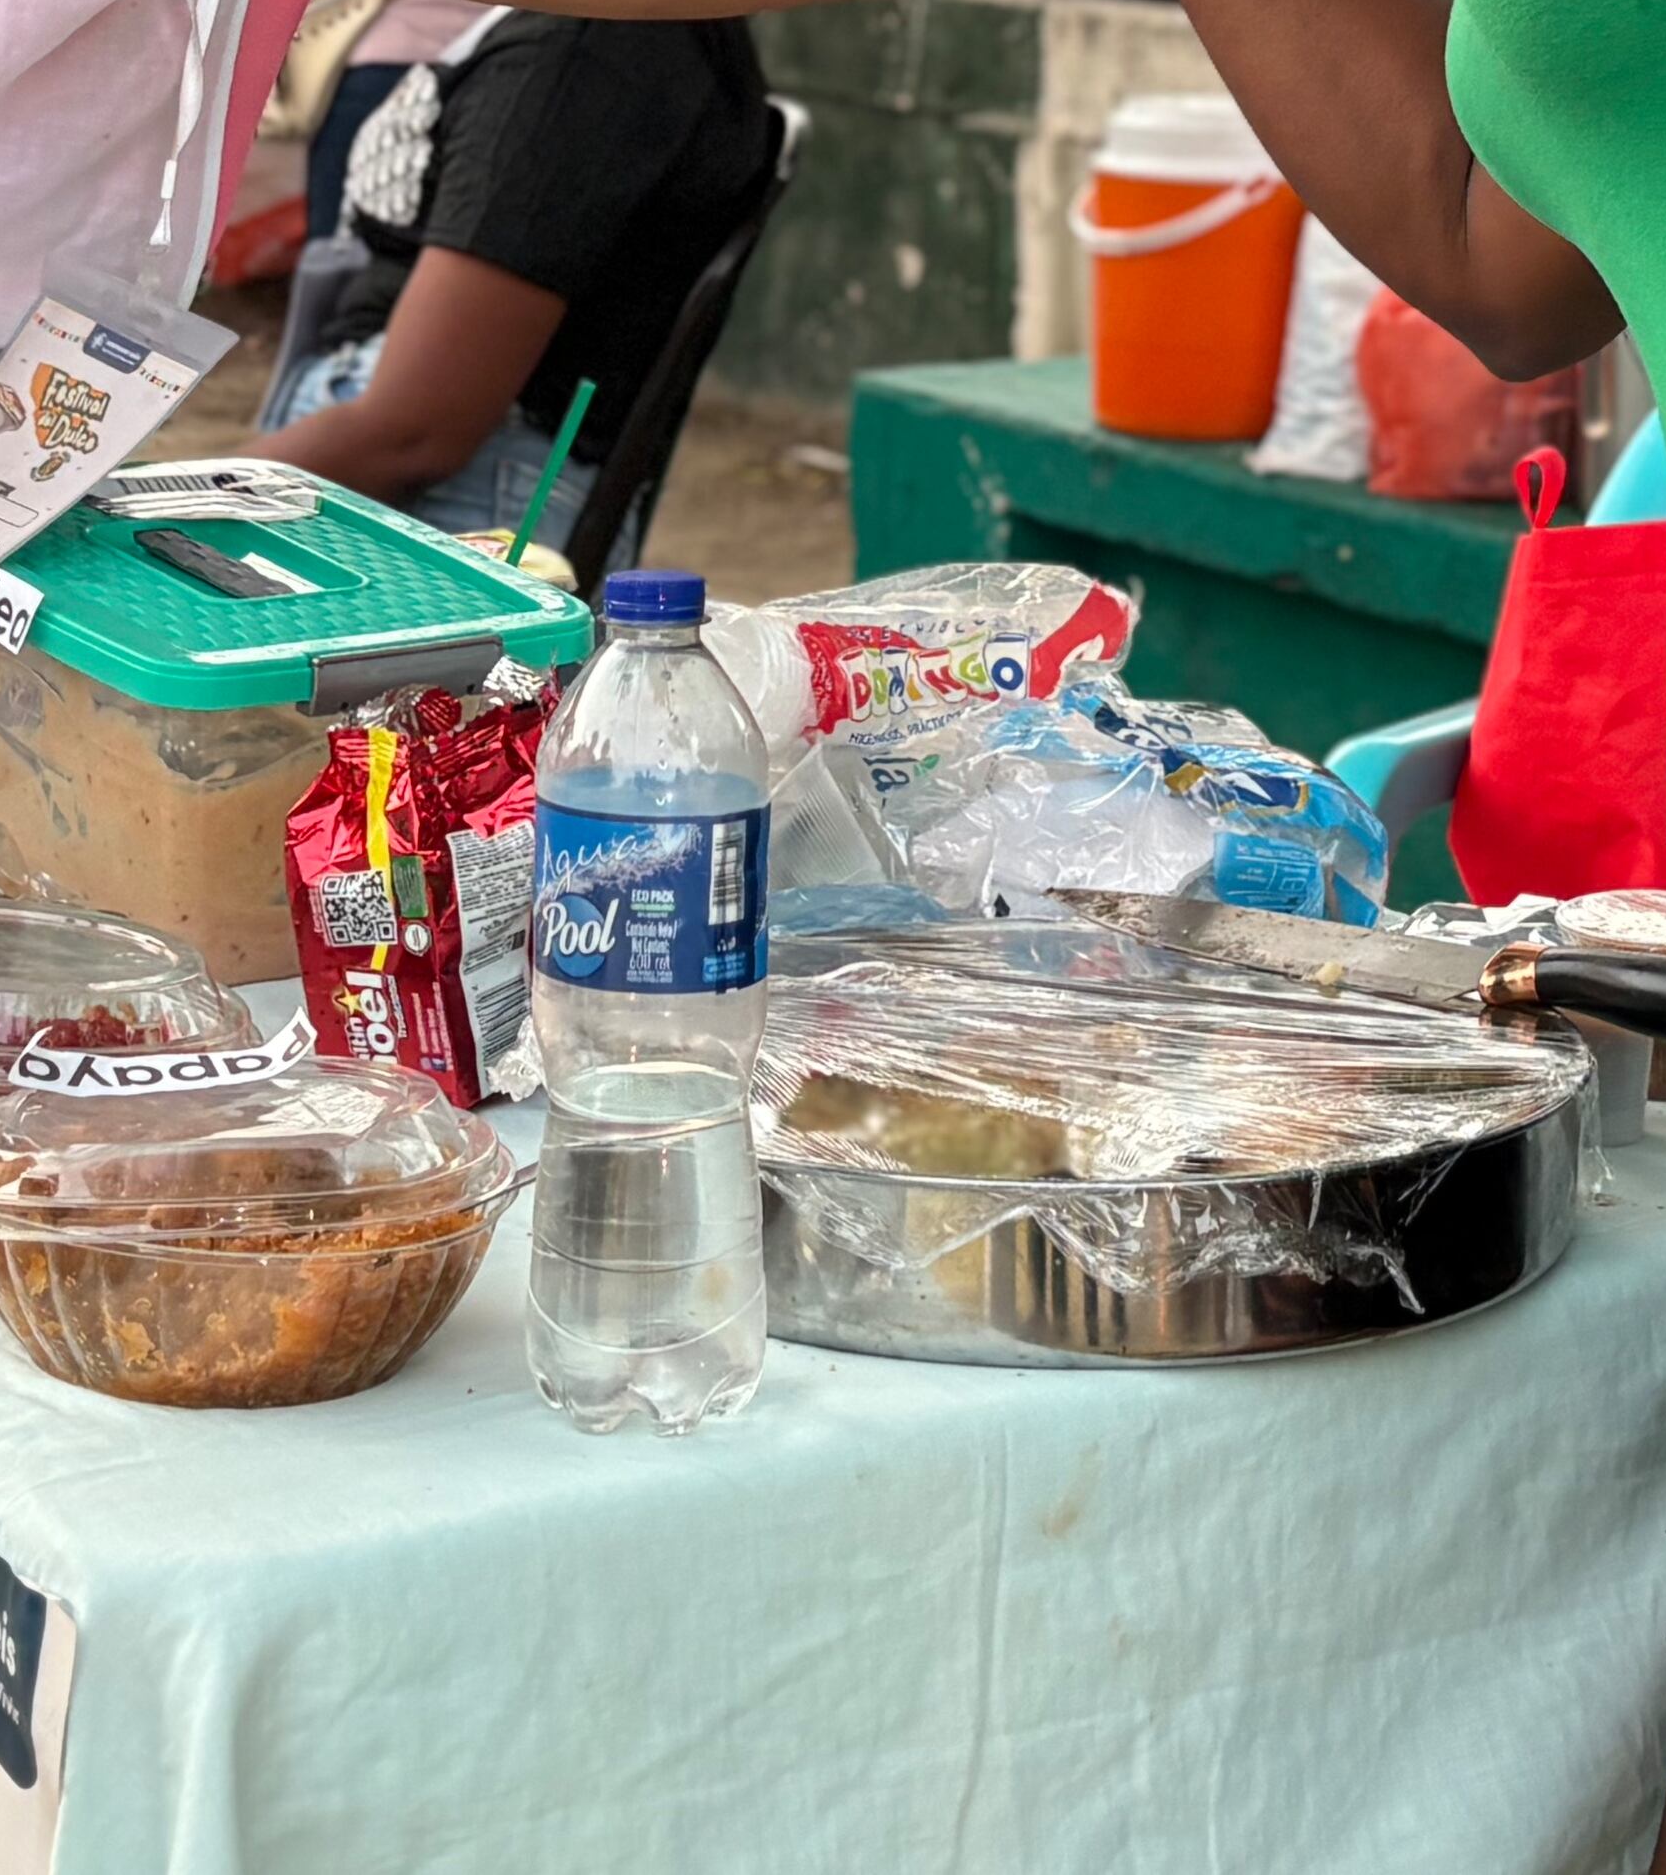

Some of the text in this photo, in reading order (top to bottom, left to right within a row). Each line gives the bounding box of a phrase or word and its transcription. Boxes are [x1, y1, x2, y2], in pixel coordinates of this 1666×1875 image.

[42, 370, 109, 419] Festival
[541, 833, 646, 900] Agua
[541, 898, 620, 957] Pool
[18, 1021, 312, 1087] Papaya
